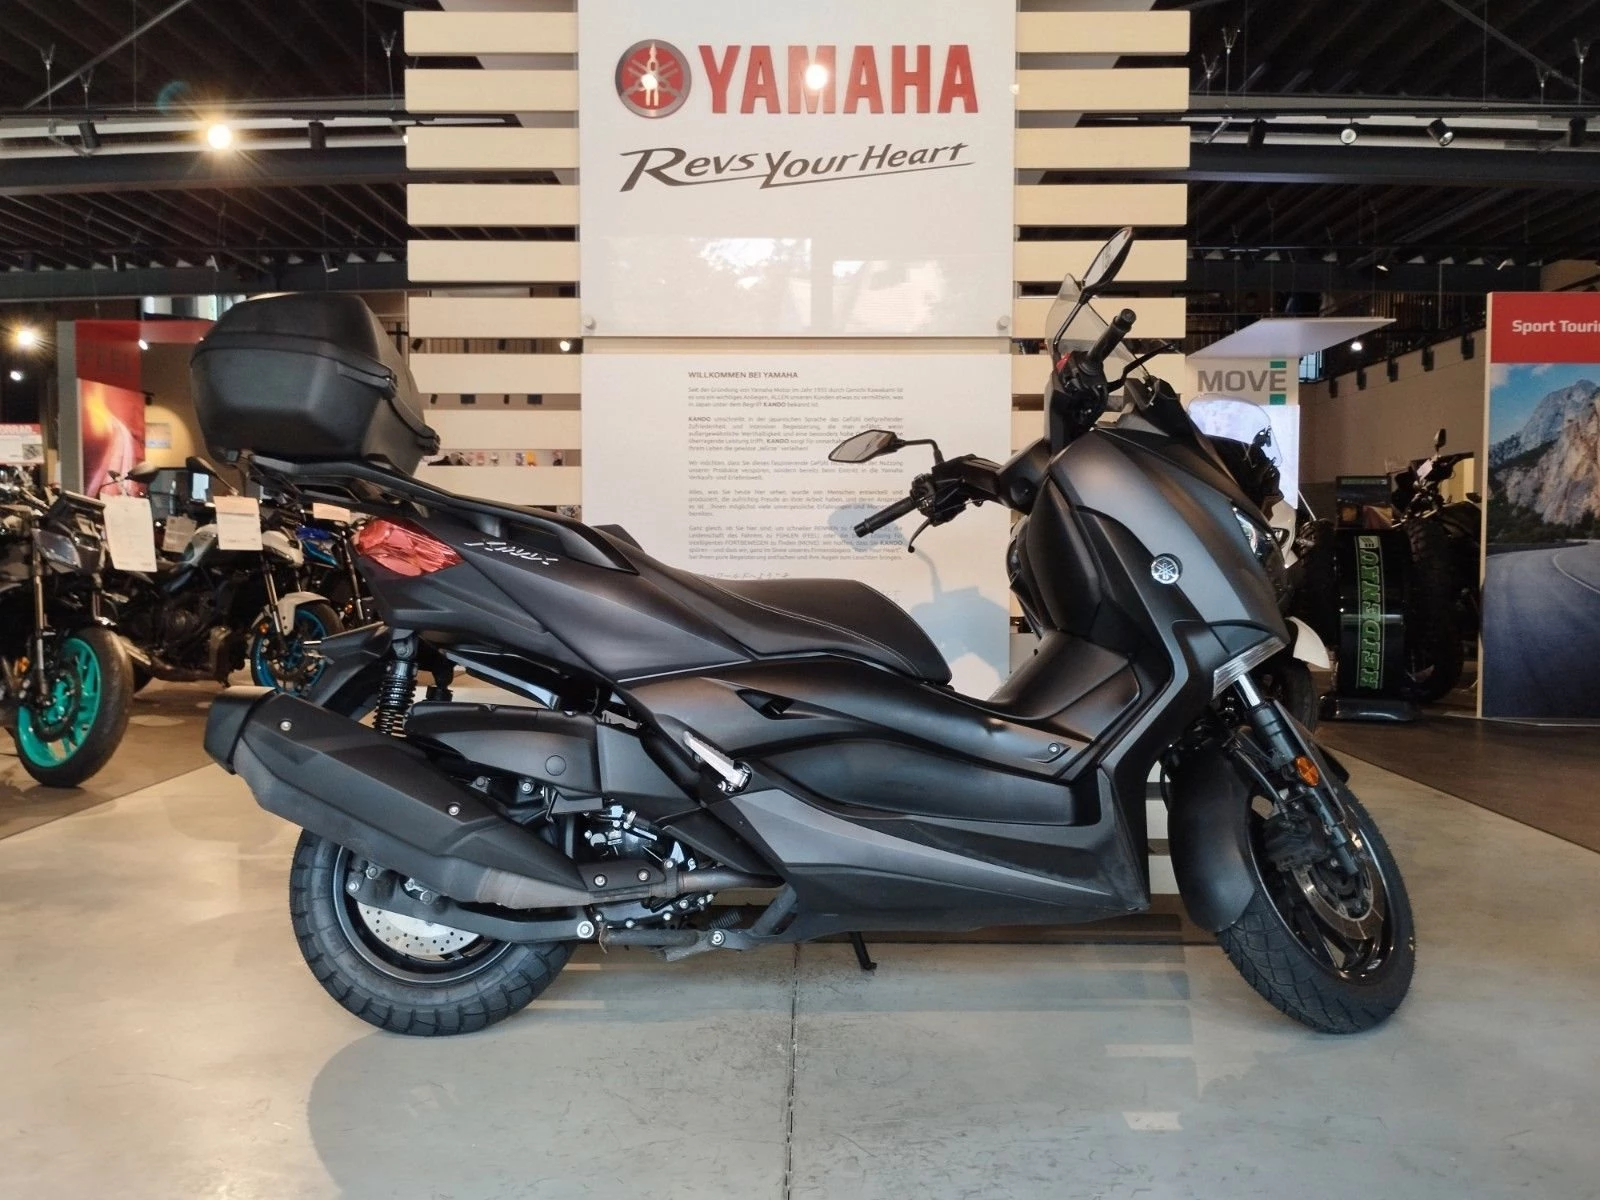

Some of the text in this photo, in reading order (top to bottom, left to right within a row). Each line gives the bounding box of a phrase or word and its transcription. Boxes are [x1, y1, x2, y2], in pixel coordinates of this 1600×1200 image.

[698, 45, 979, 114] YAMAHA
[619, 142, 970, 192] Revs Your Heart
[1512, 320, 1556, 335] Sport
[688, 371, 799, 379] WILLKOMMEN BEI YAMAHA
[1197, 370, 1287, 392] MOVE
[1360, 549, 1381, 690] HEIDENAU
